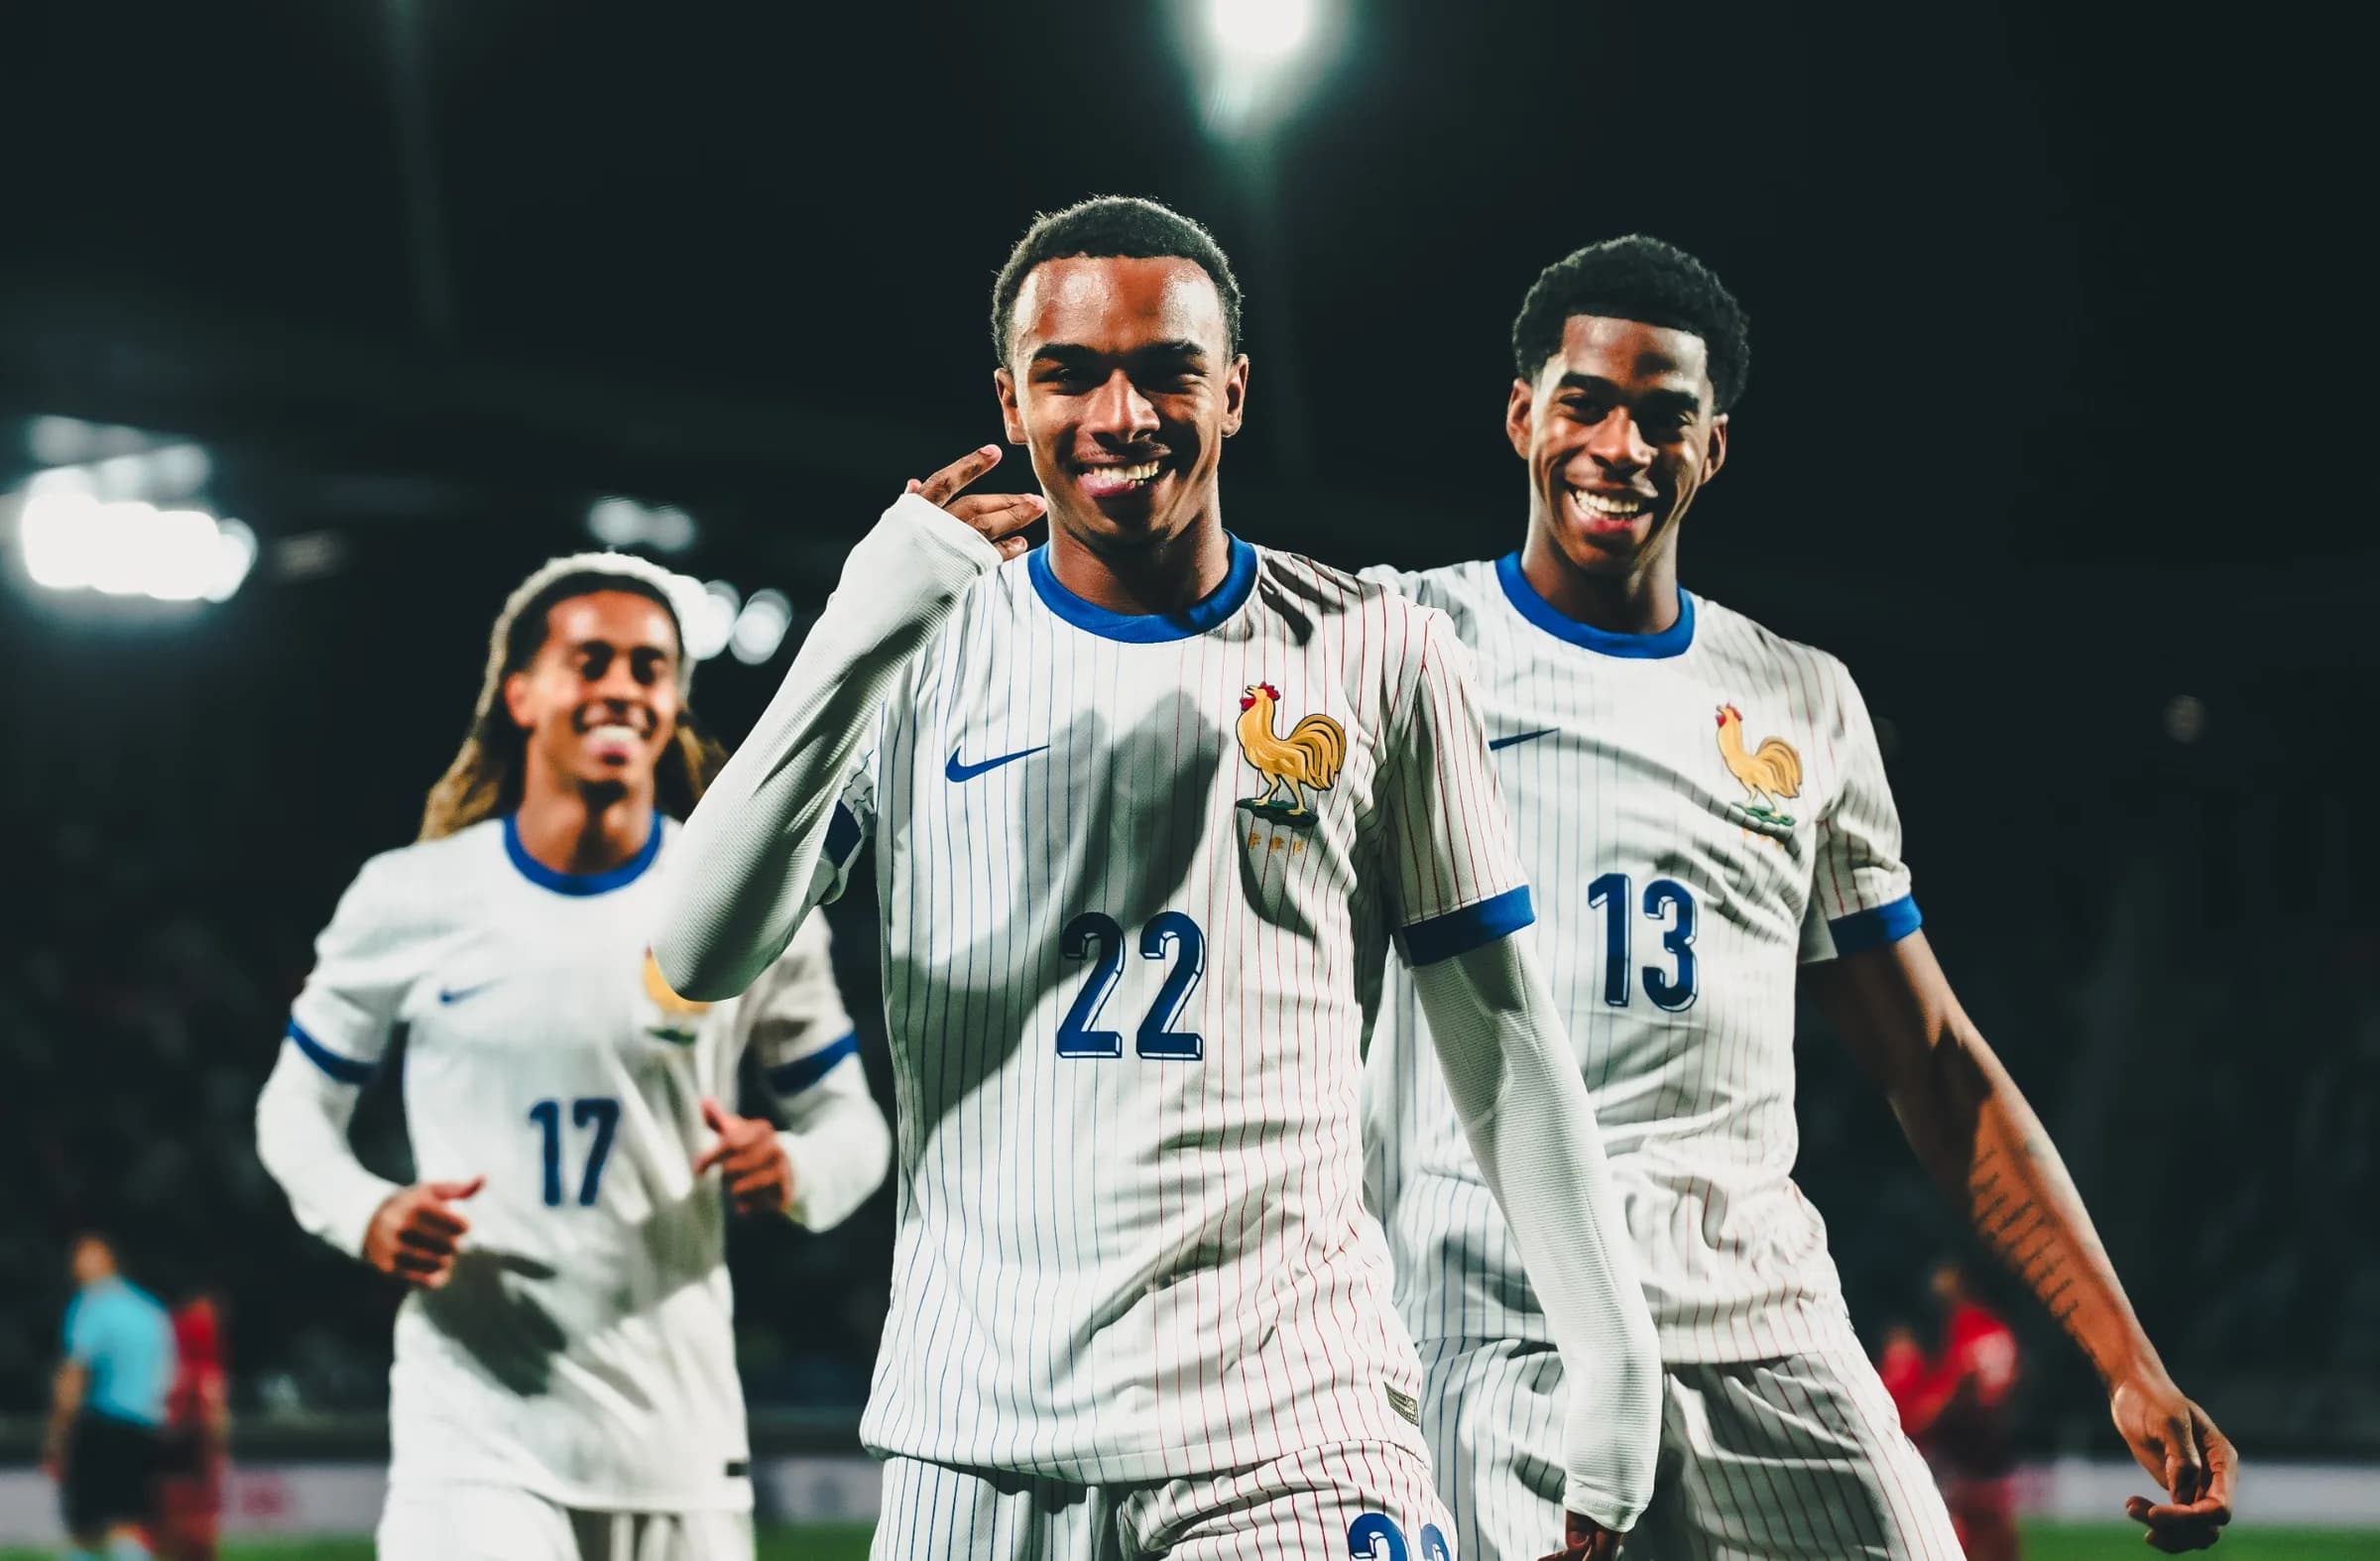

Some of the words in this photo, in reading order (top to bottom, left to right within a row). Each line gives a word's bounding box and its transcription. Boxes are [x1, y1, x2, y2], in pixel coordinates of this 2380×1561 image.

[1056, 910, 1206, 1061] 22
[1588, 873, 1699, 1014] 13
[529, 1098, 620, 1207] 17
